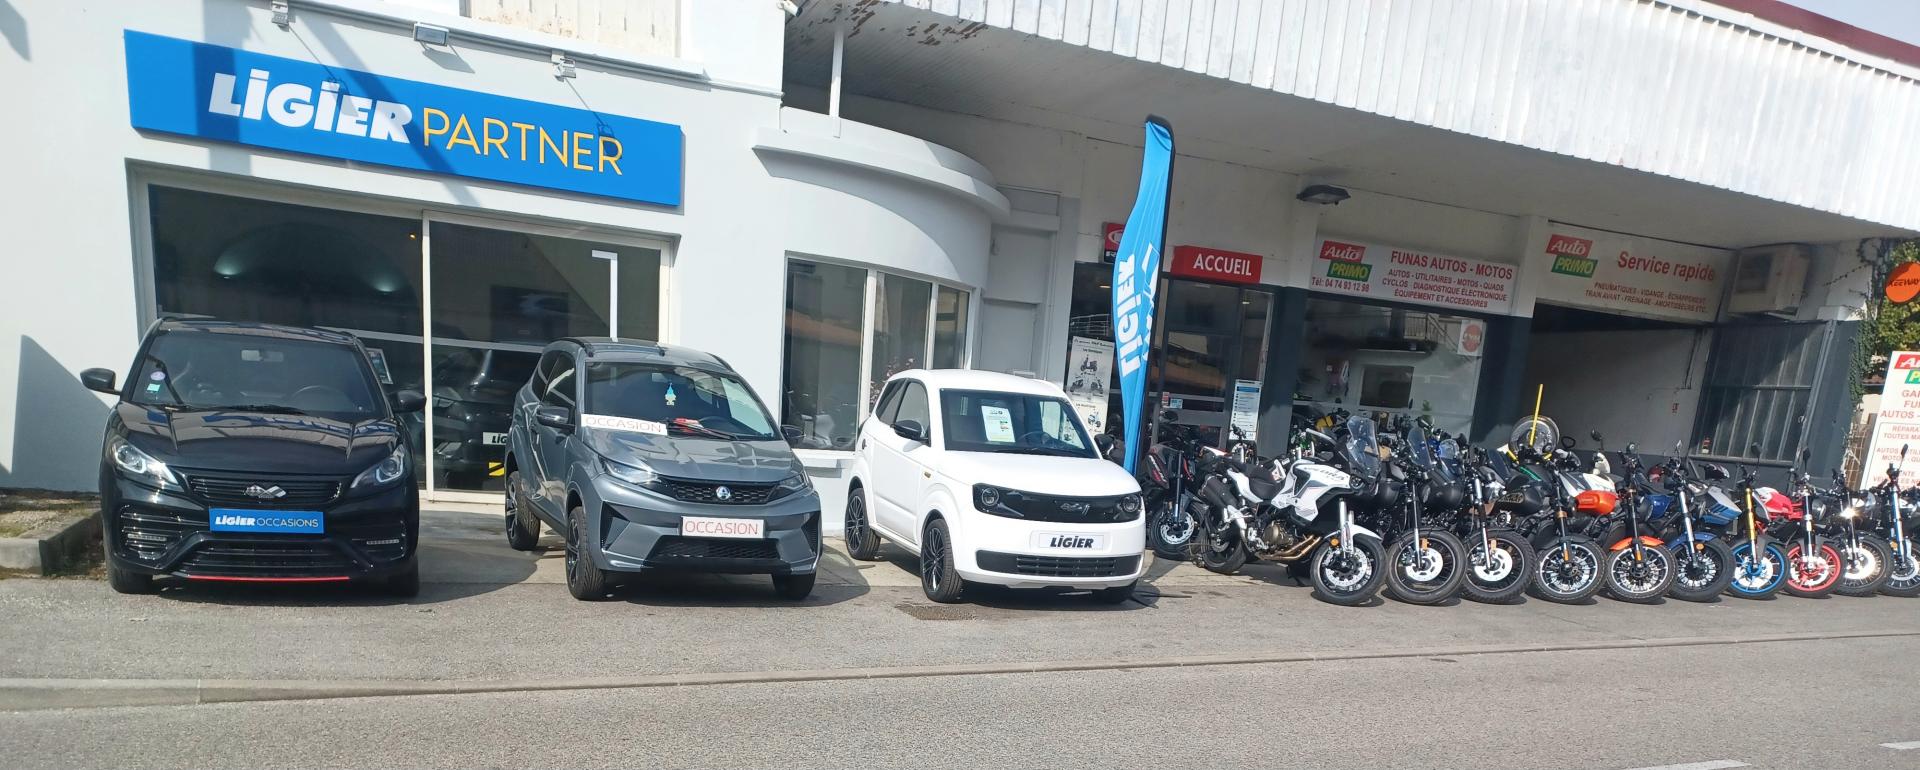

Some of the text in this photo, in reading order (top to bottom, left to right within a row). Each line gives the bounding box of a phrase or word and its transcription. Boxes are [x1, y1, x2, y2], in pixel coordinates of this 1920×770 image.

[423, 107, 623, 176] PARTNER
[1324, 246, 1360, 260] Auto
[1551, 239, 1586, 255] Auto
[1193, 253, 1252, 276] ACCUEIL
[1330, 262, 1369, 279] PRIMO
[1391, 250, 1428, 267] FUNAS
[1430, 256, 1467, 273] AUTOS
[1475, 264, 1513, 280] MOTOS
[1555, 257, 1593, 274] PRIMO
[1618, 251, 1715, 282] Service rapide
[1382, 278, 1408, 288] CYCLOS
[1413, 282, 1460, 296] DIAGNOSTIQUE
[1388, 268, 1410, 279] AUTOS
[1415, 272, 1452, 284] UTILITAIRES
[1457, 279, 1479, 288] MOTOS
[1483, 282, 1504, 291] QUADS
[1880, 410, 1914, 419] AUTOS
[585, 416, 661, 433] OCCASION
[256, 518, 319, 528] OCCASIONS
[685, 520, 758, 535] OCCASION
